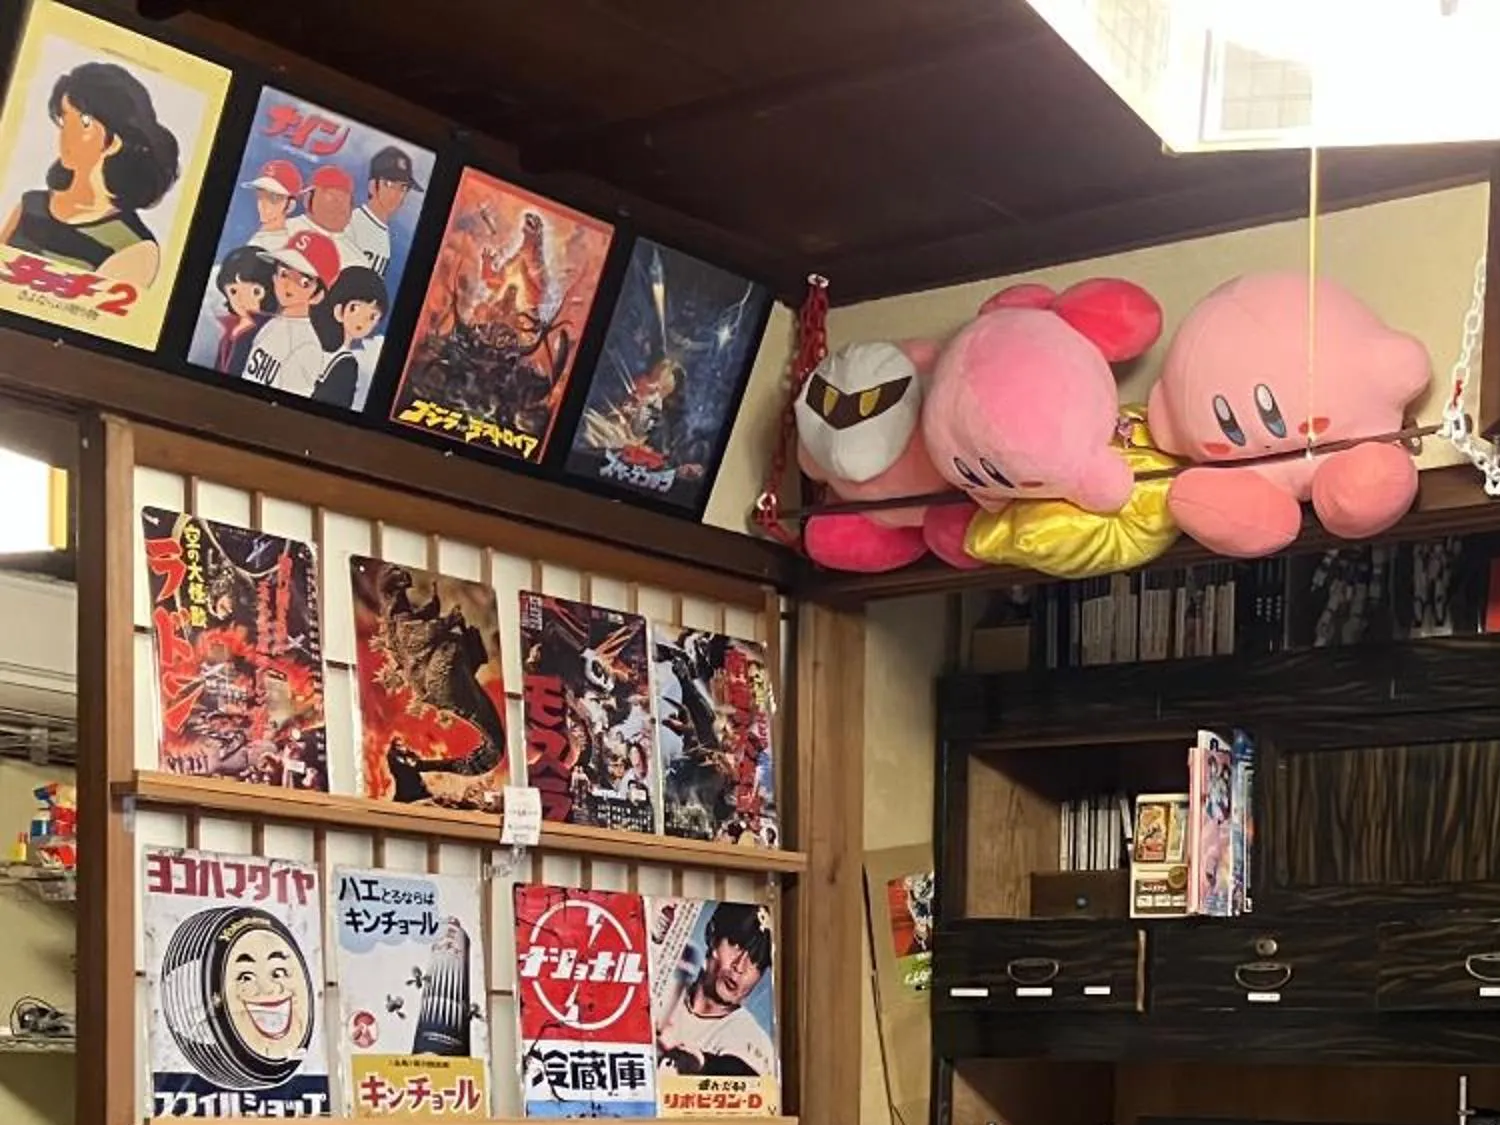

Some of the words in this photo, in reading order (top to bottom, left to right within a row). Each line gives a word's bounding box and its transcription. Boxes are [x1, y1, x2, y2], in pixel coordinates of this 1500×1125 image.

[96, 283, 138, 317] 2
[248, 348, 282, 386] SHU
[399, 400, 463, 431] ゴジラ
[147, 853, 316, 905] ヨコハマタイヤ
[345, 907, 439, 936] キンチョール
[519, 945, 645, 985] ナショナル
[531, 1050, 646, 1091] 冷蔵庫
[361, 1074, 481, 1111] キンチョール
